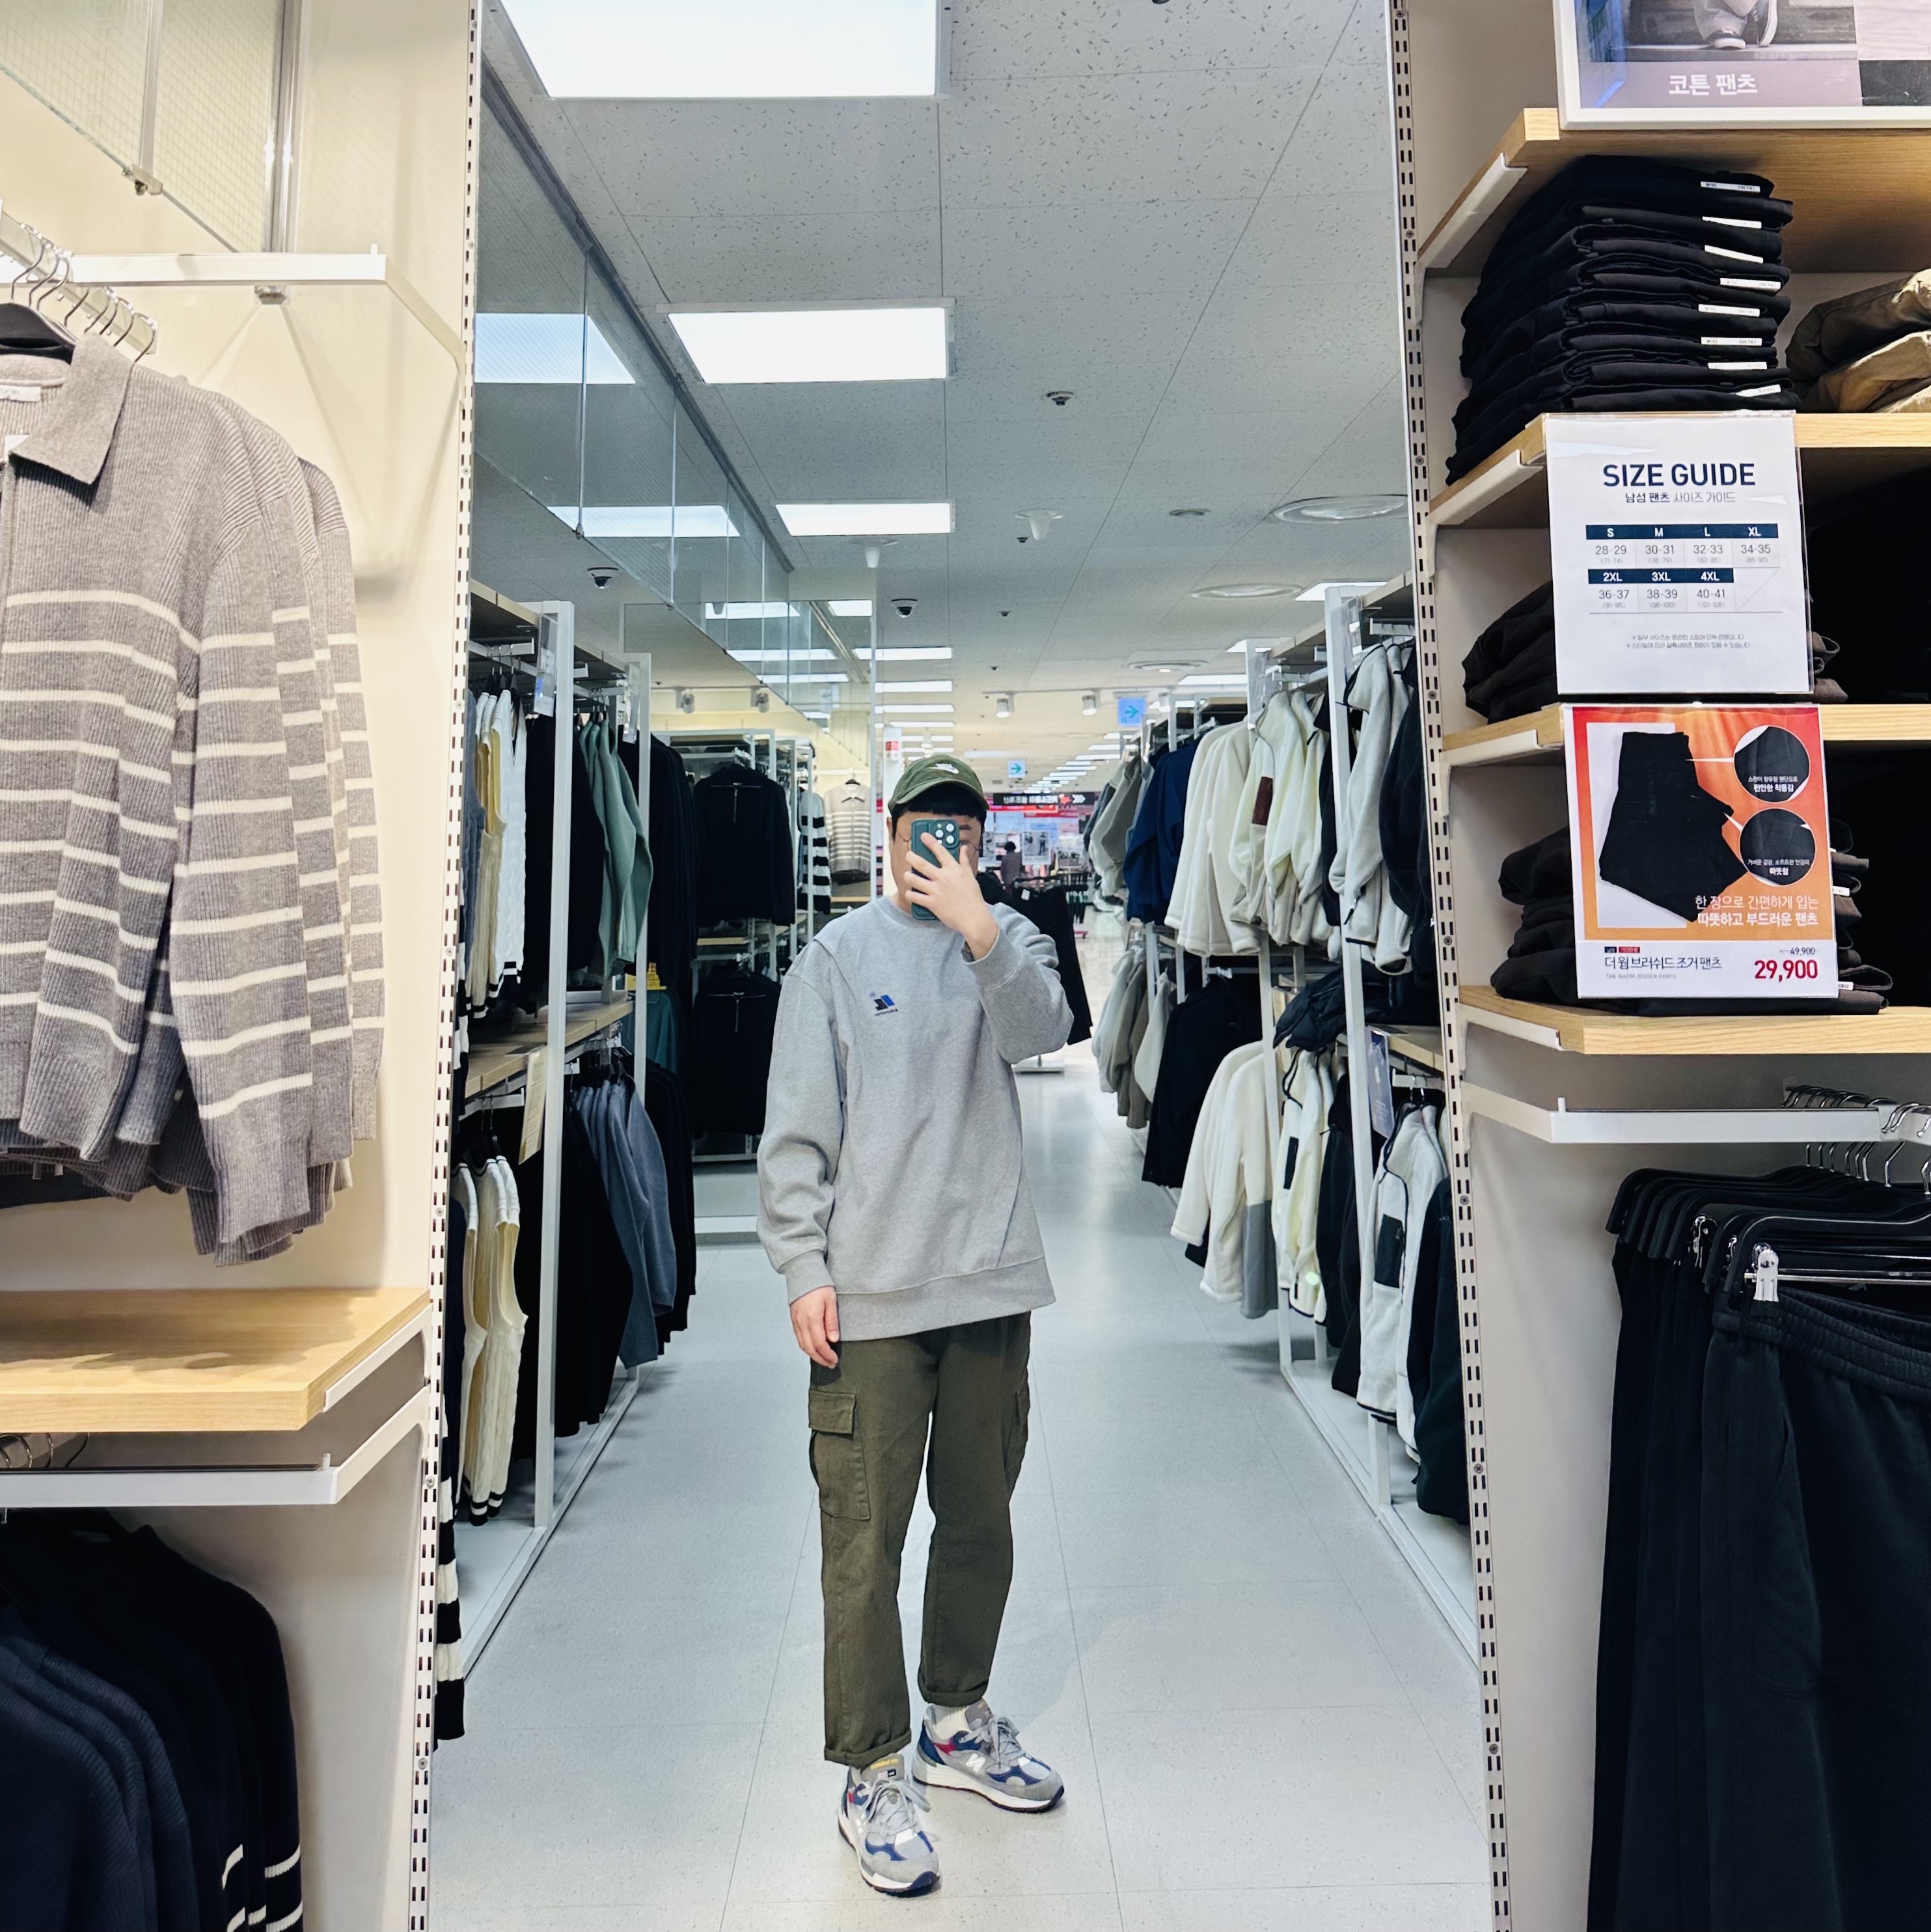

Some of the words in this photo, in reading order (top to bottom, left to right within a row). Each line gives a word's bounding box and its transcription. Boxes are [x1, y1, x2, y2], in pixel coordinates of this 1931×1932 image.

[1669, 74, 1710, 96] 코튼
[1716, 74, 1758, 95] 팬츠
[1603, 464, 1664, 487] SIZE
[1671, 463, 1756, 486] GUIDE
[1625, 492, 1646, 503] 남성
[1649, 492, 1670, 503] 팬츠
[1673, 492, 1705, 503] 사이즈
[1706, 491, 1736, 503] 가이드
[1607, 528, 1614, 538] S
[1654, 527, 1664, 537] M
[1704, 527, 1711, 536] L
[1748, 527, 1762, 536] XL
[1595, 545, 1627, 555] 28-29
[1645, 545, 1674, 555] 30-31
[1693, 544, 1723, 553] 32-33
[1741, 544, 1771, 553] 34-35
[1603, 572, 1623, 582] 2XL
[1652, 572, 1671, 582] 3XL
[1701, 572, 1719, 581] 4XL
[1598, 590, 1630, 599] 36-37
[1647, 589, 1678, 599] 38-39
[1697, 588, 1725, 599] 40-41
[1695, 895, 1706, 910] 한
[1710, 895, 1745, 910] 장으로
[1748, 895, 1792, 910] 간편하게
[1796, 895, 1820, 910] 입는
[1697, 913, 1744, 927] 따뜻하고
[1746, 913, 1793, 927] 부드러운
[1795, 913, 1818, 927] 팬츠
[1790, 947, 1816, 956] 49,900
[1754, 959, 1818, 983] 29,900
